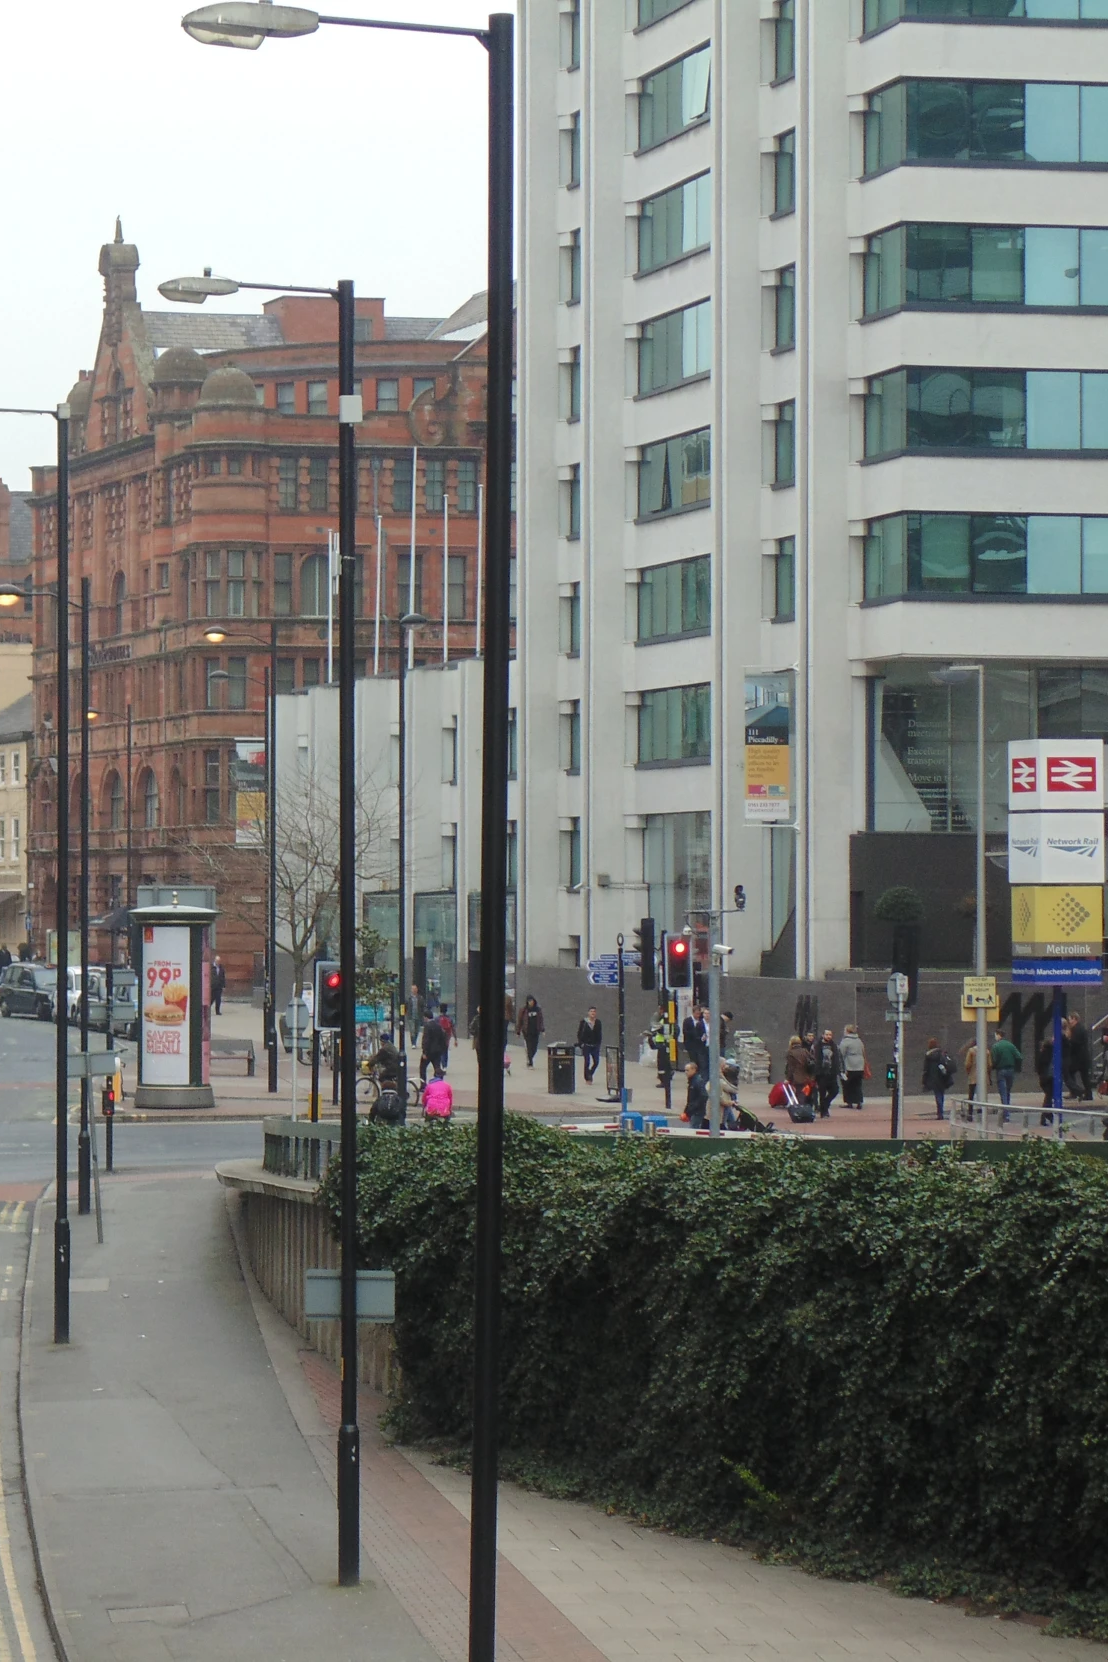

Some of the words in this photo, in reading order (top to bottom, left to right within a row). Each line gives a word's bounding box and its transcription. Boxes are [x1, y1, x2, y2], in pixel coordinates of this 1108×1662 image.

[749, 736, 779, 744] Piccadilly
[1047, 837, 1082, 845] Network
[1083, 837, 1099, 845] Rail
[1046, 944, 1091, 954] Metrolink
[1036, 968, 1072, 976] Manchester
[1072, 968, 1102, 977] Piccadilly
[146, 1029, 181, 1041] SAVER
[146, 1039, 181, 1054] MENU
